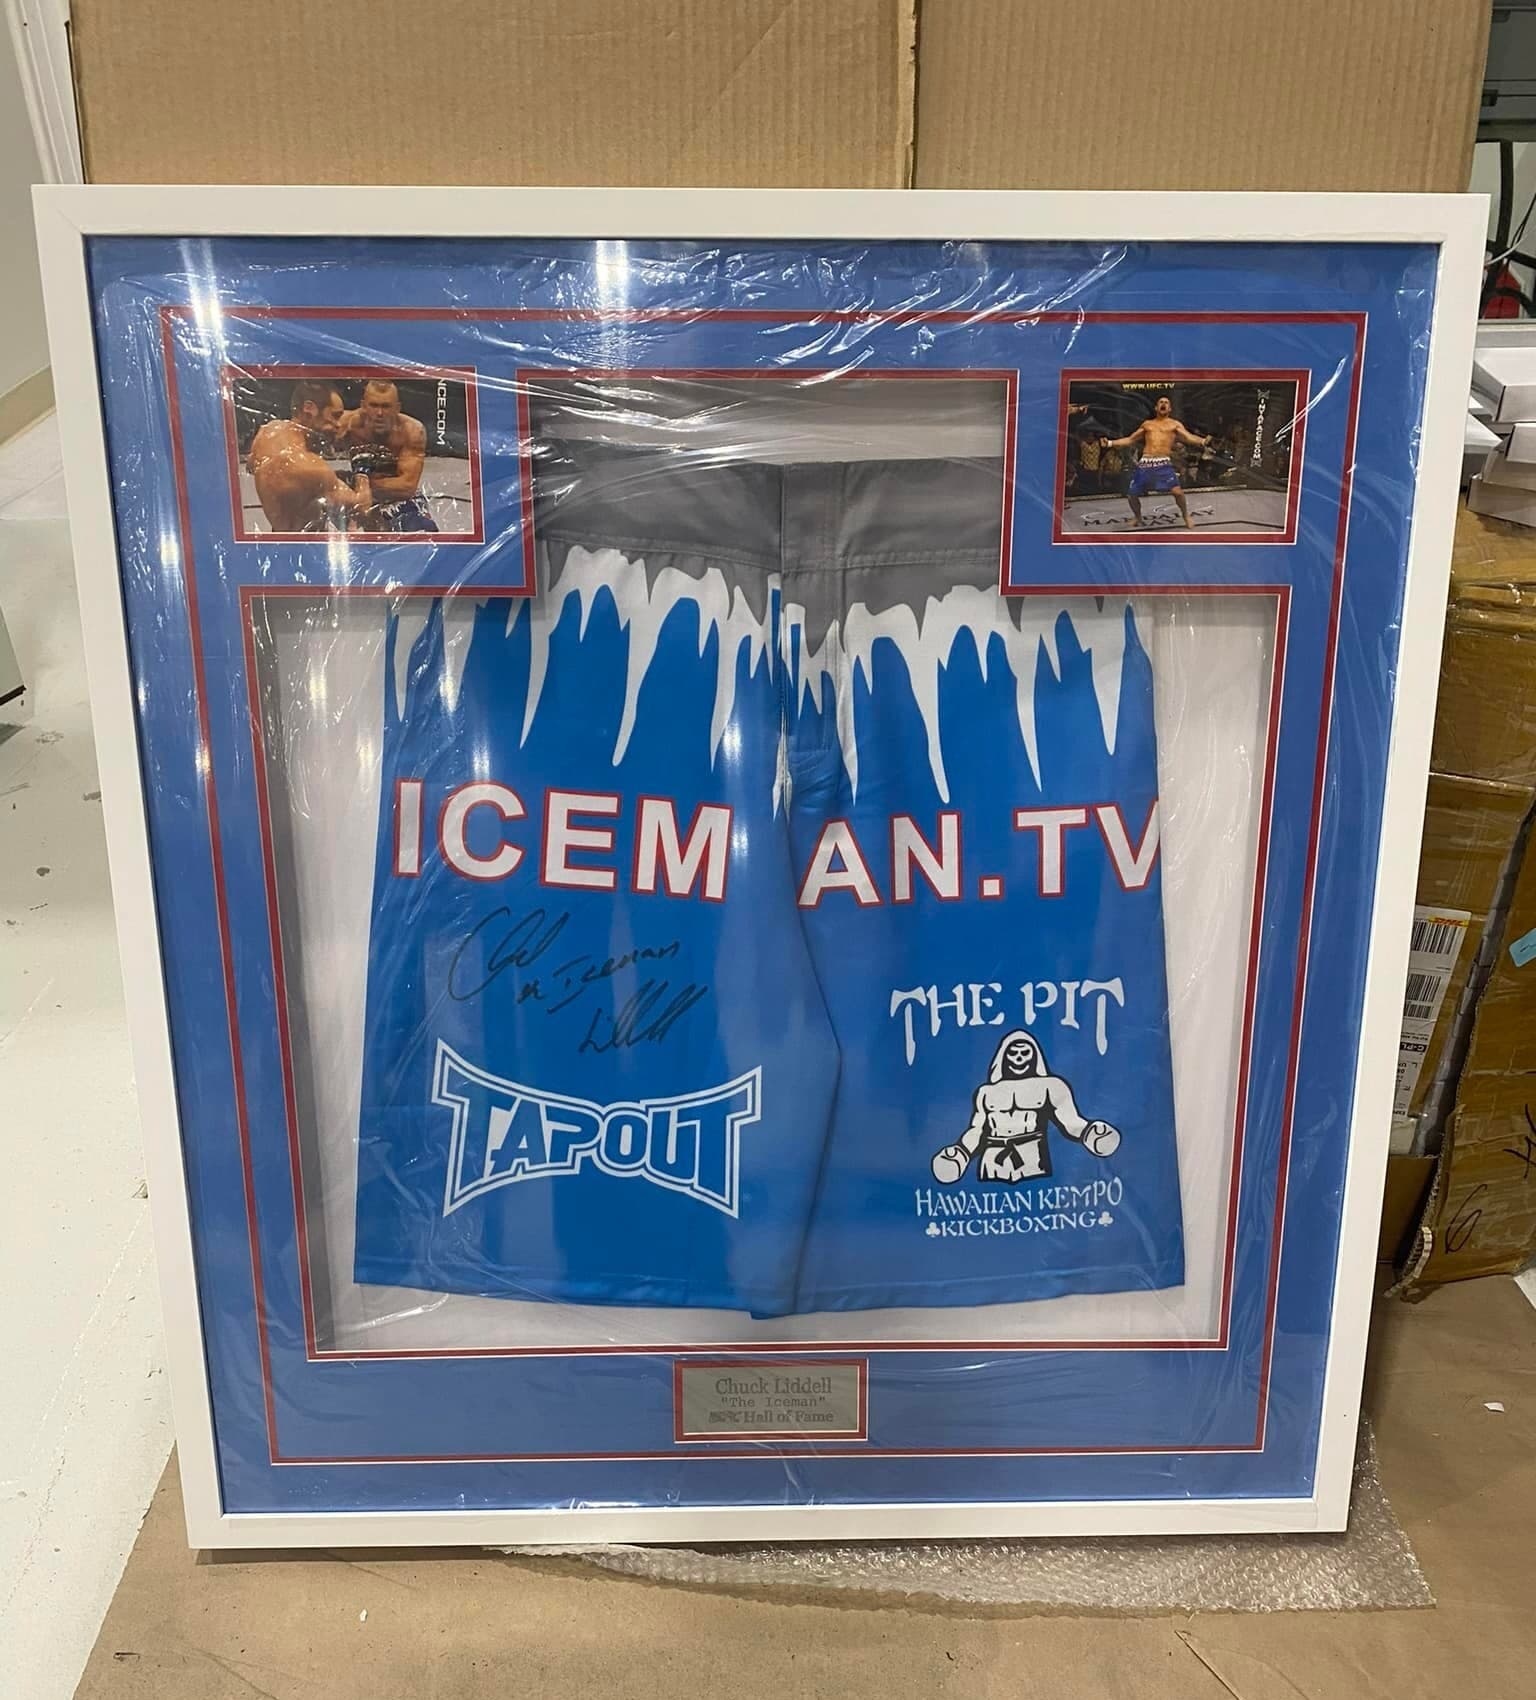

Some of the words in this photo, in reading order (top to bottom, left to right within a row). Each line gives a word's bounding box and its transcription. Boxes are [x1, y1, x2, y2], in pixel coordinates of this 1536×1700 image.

[890, 982, 1006, 1067] THE
[1020, 976, 1126, 1057] PIT
[431, 1037, 763, 1219] TAPOUT
[914, 1187, 1033, 1217] HAWAIIAN
[1038, 1175, 1124, 1210] KEMPO
[941, 1210, 1100, 1238] KICKBOXING
[715, 1377, 770, 1395] Chuck
[774, 1376, 833, 1394] Liddell
[743, 1410, 773, 1423] Hall
[776, 1409, 793, 1423] of
[795, 1410, 834, 1423] Fame
